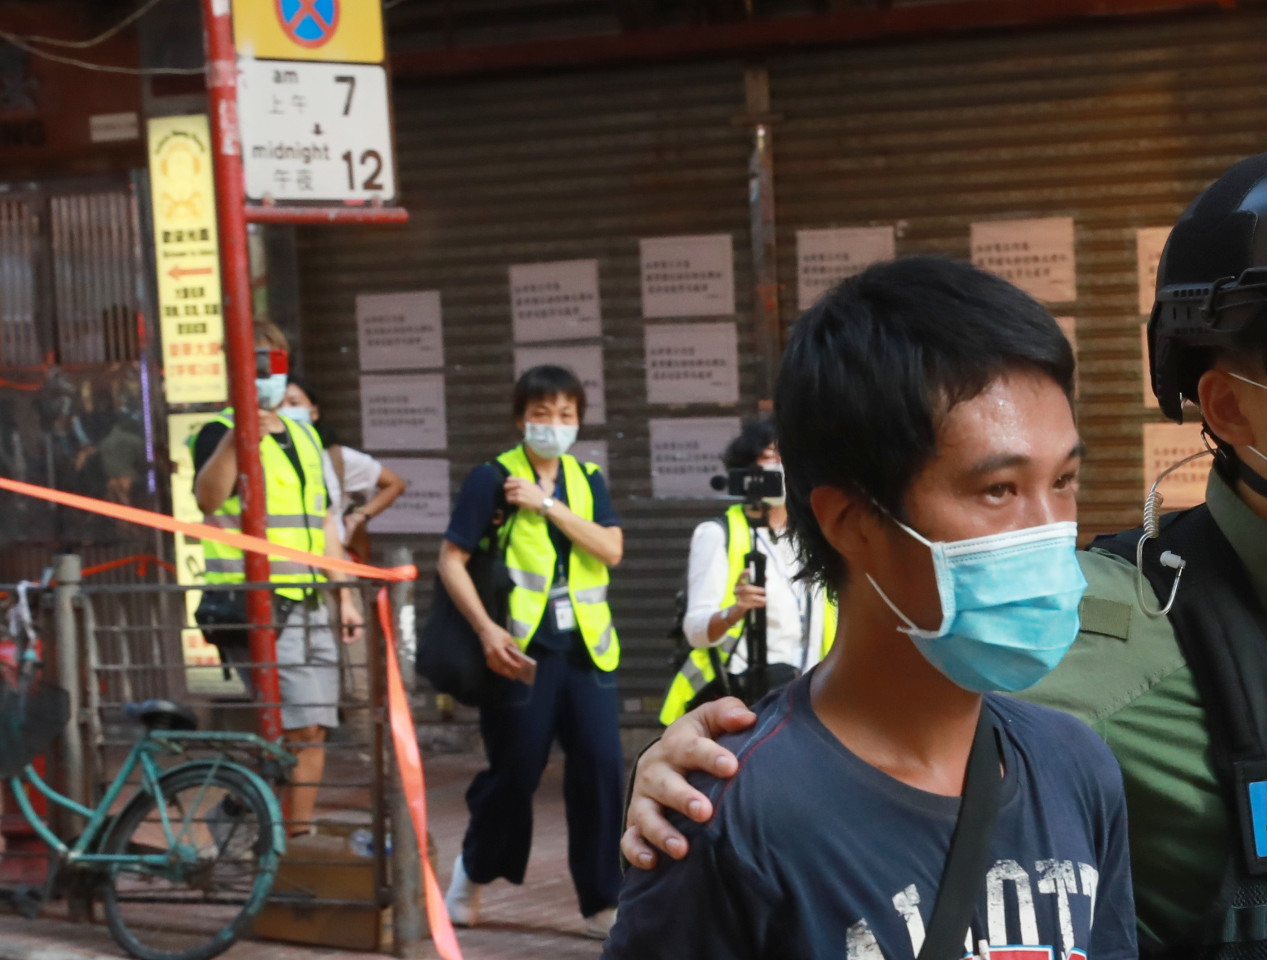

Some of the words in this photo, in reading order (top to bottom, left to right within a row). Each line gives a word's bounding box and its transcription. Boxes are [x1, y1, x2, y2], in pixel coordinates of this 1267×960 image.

[268, 93, 308, 115] 上午
[273, 70, 299, 84] am
[334, 75, 356, 116] 7
[252, 141, 331, 164] midnight
[341, 149, 384, 191] 12
[274, 168, 314, 192] 午夜
